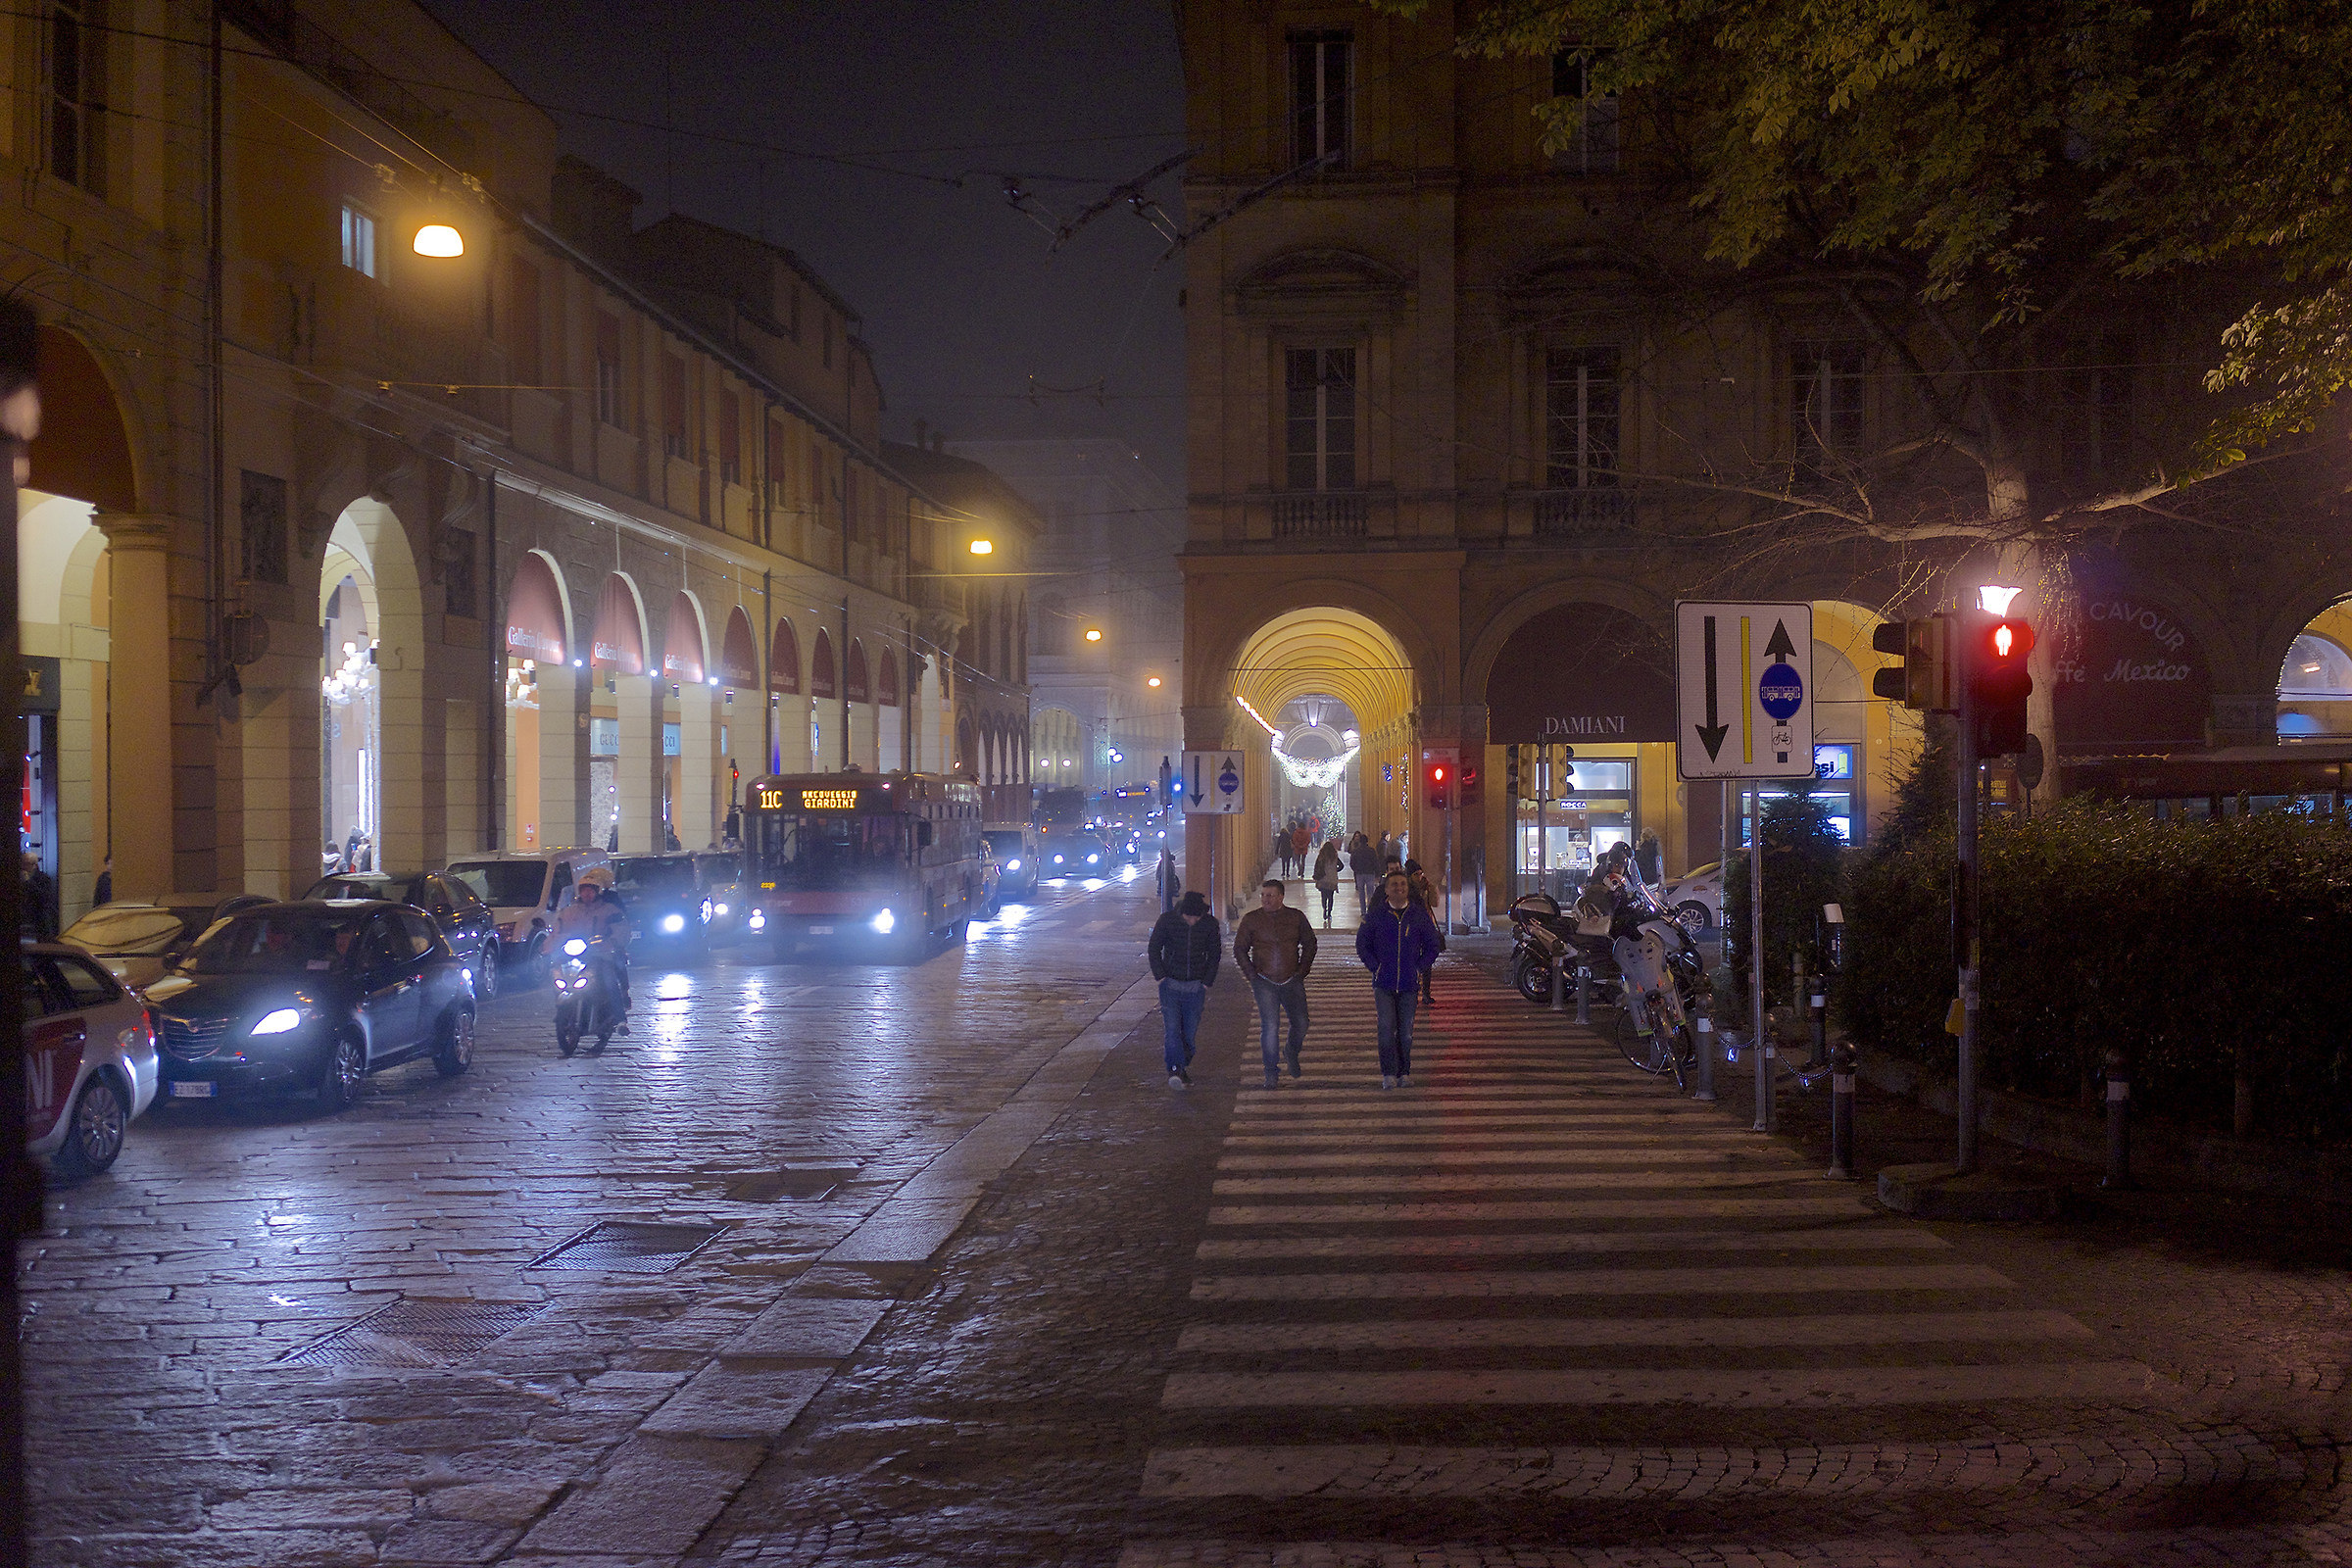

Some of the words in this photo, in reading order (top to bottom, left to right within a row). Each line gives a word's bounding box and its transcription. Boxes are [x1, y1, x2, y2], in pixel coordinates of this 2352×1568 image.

[508, 626, 535, 648] Galleria
[2089, 602, 2184, 652] CAVOUR
[2103, 659, 2190, 683] Mexico
[1545, 715, 1626, 735] DAMIANI
[760, 790, 783, 809] 11C
[802, 790, 858, 800] ARCOVEGGIO
[804, 799, 856, 809] GIARDINI
